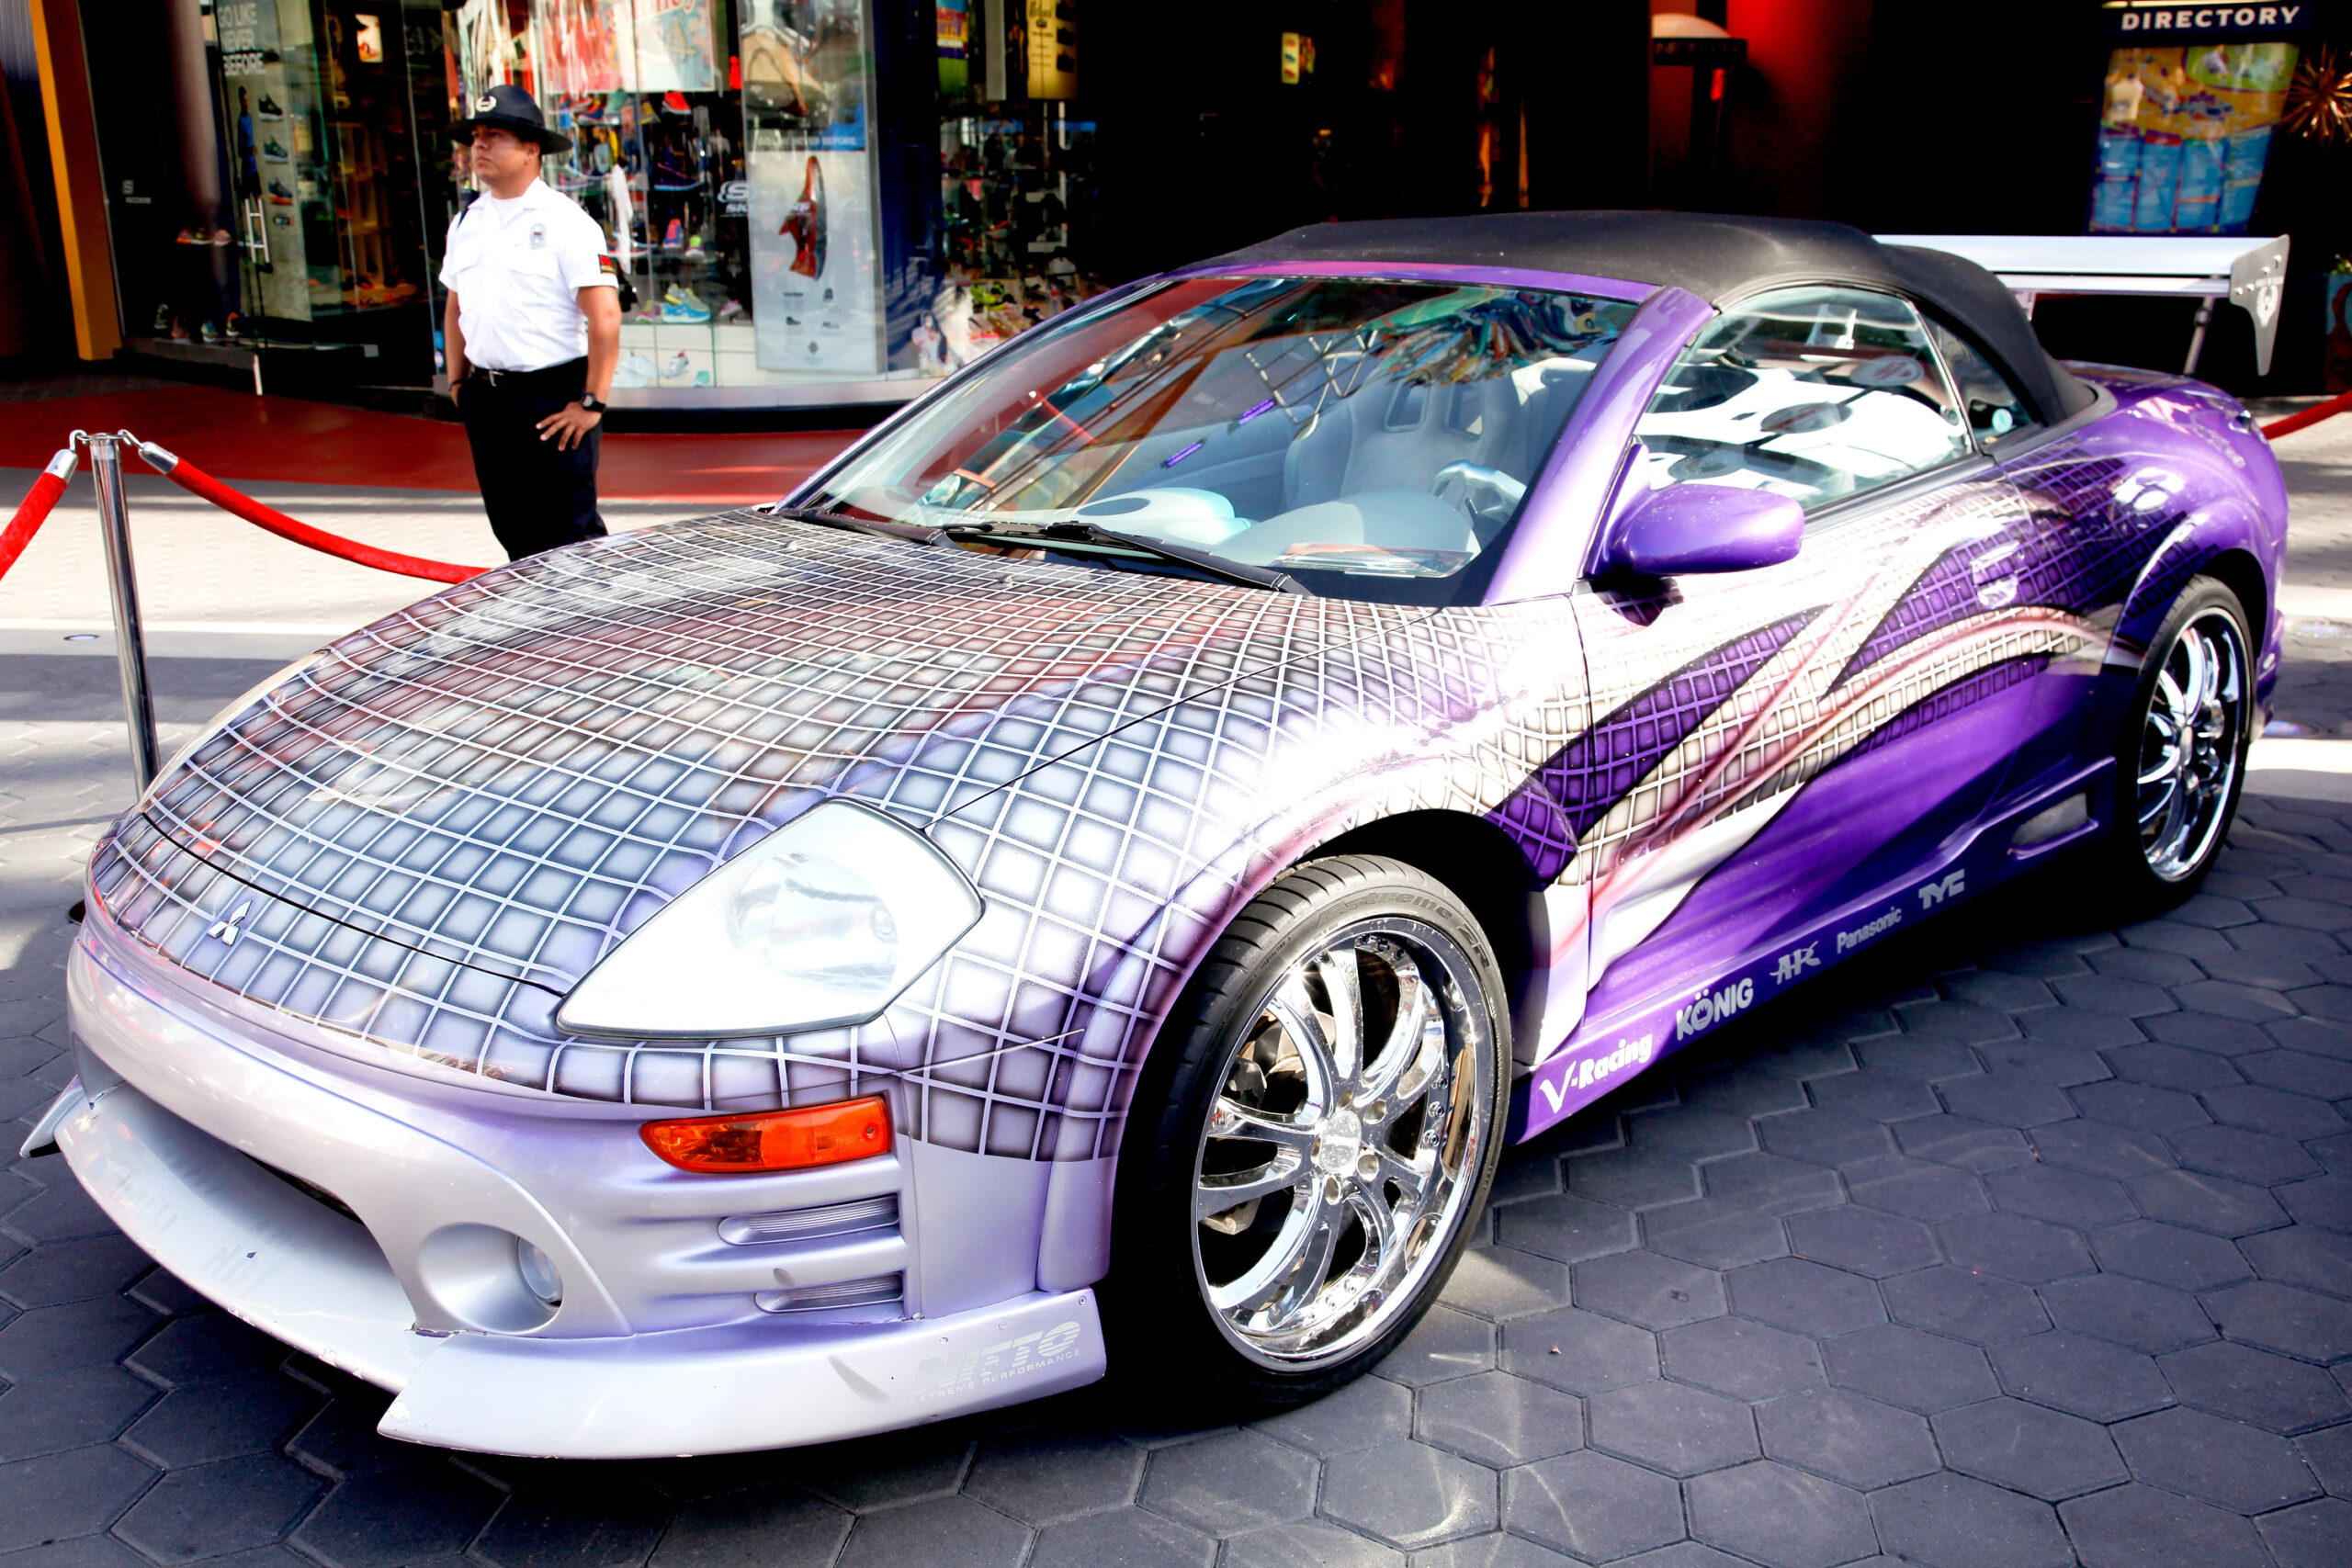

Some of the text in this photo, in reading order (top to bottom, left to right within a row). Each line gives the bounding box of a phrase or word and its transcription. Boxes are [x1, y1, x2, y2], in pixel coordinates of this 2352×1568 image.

[234, 3, 258, 27] LIKE
[2121, 6, 2300, 30] DIRECTORY
[1918, 869, 1965, 909] TYC
[1837, 906, 1903, 954] Panasonic
[1676, 977, 1754, 1041] KÖNIG
[1539, 1033, 1653, 1114] V-Racing
[909, 1348, 1081, 1405] EXTREME PERFORMANCE
